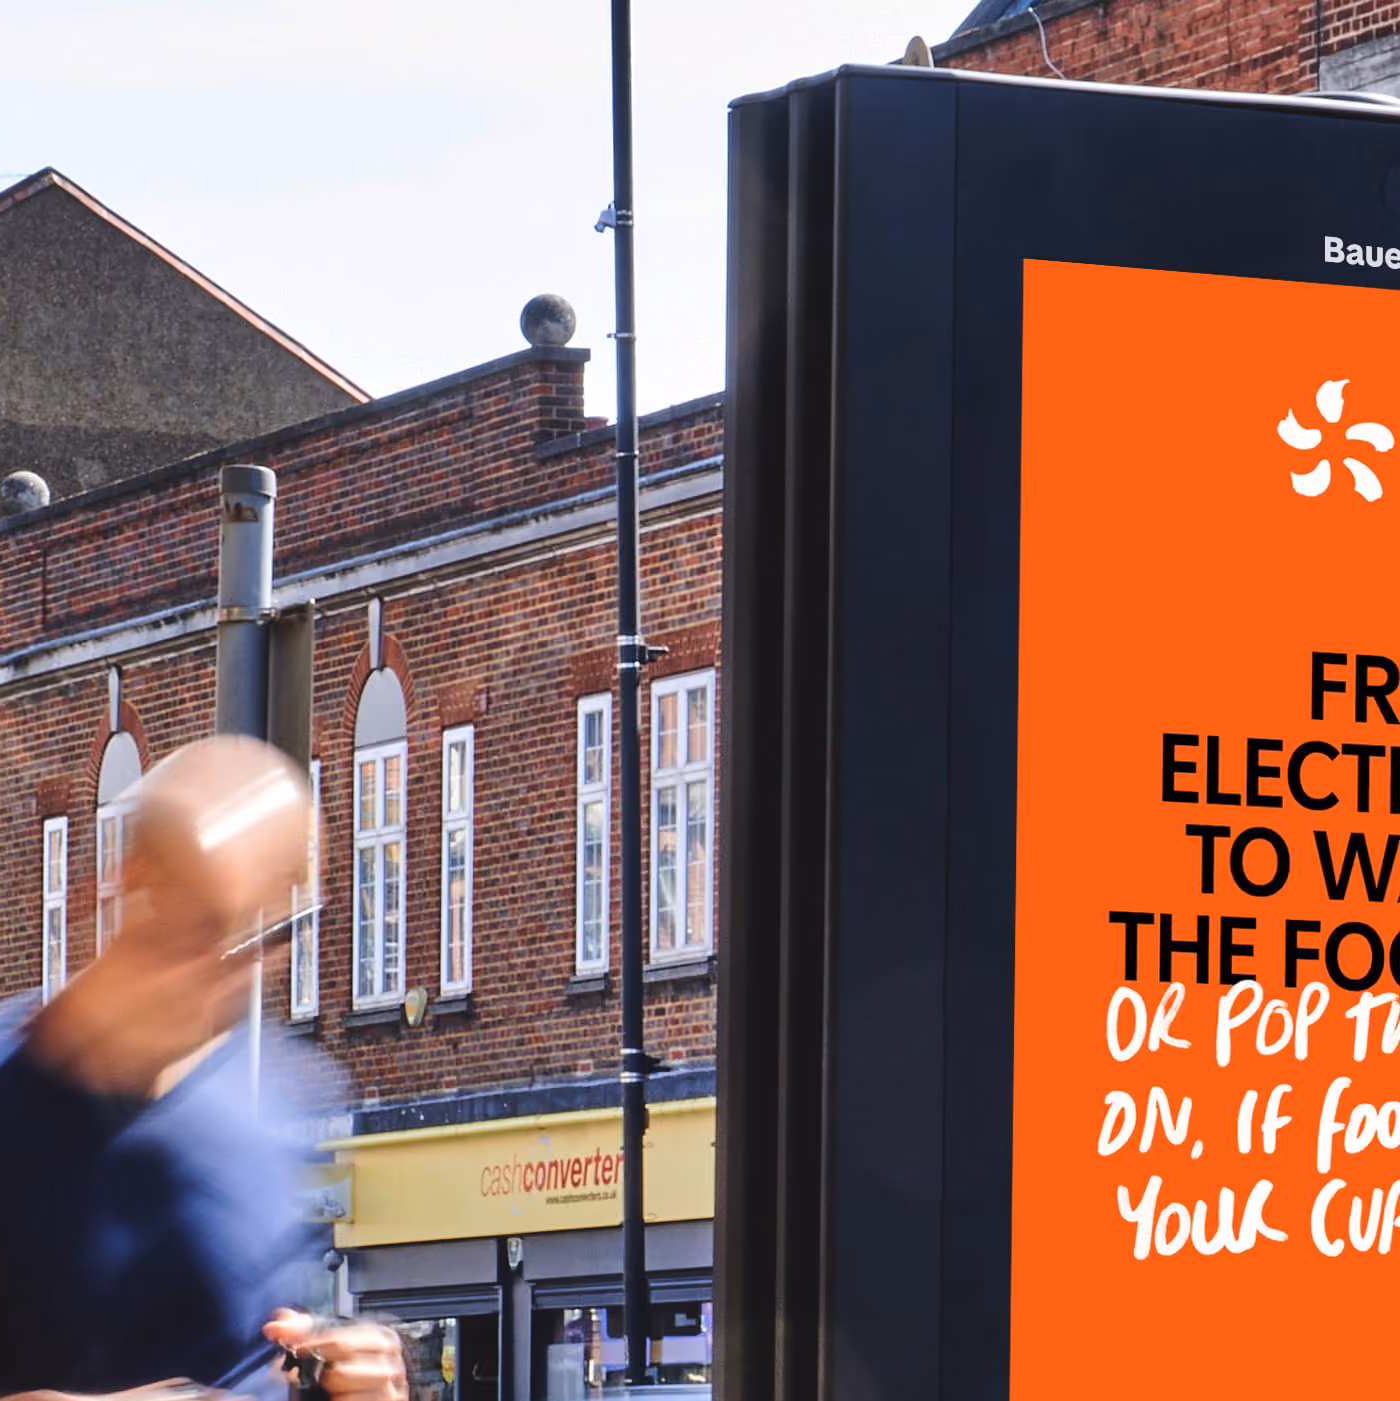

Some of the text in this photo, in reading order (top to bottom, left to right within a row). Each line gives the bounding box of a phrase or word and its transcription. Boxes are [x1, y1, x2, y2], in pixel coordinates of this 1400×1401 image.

[1185, 824, 1290, 896] TO
[1109, 911, 1257, 987] THE
[1106, 982, 1191, 1062] OR
[1216, 979, 1329, 1067] POP
[1239, 1084, 1292, 1154] IF
[1117, 1175, 1288, 1260] YOUR
